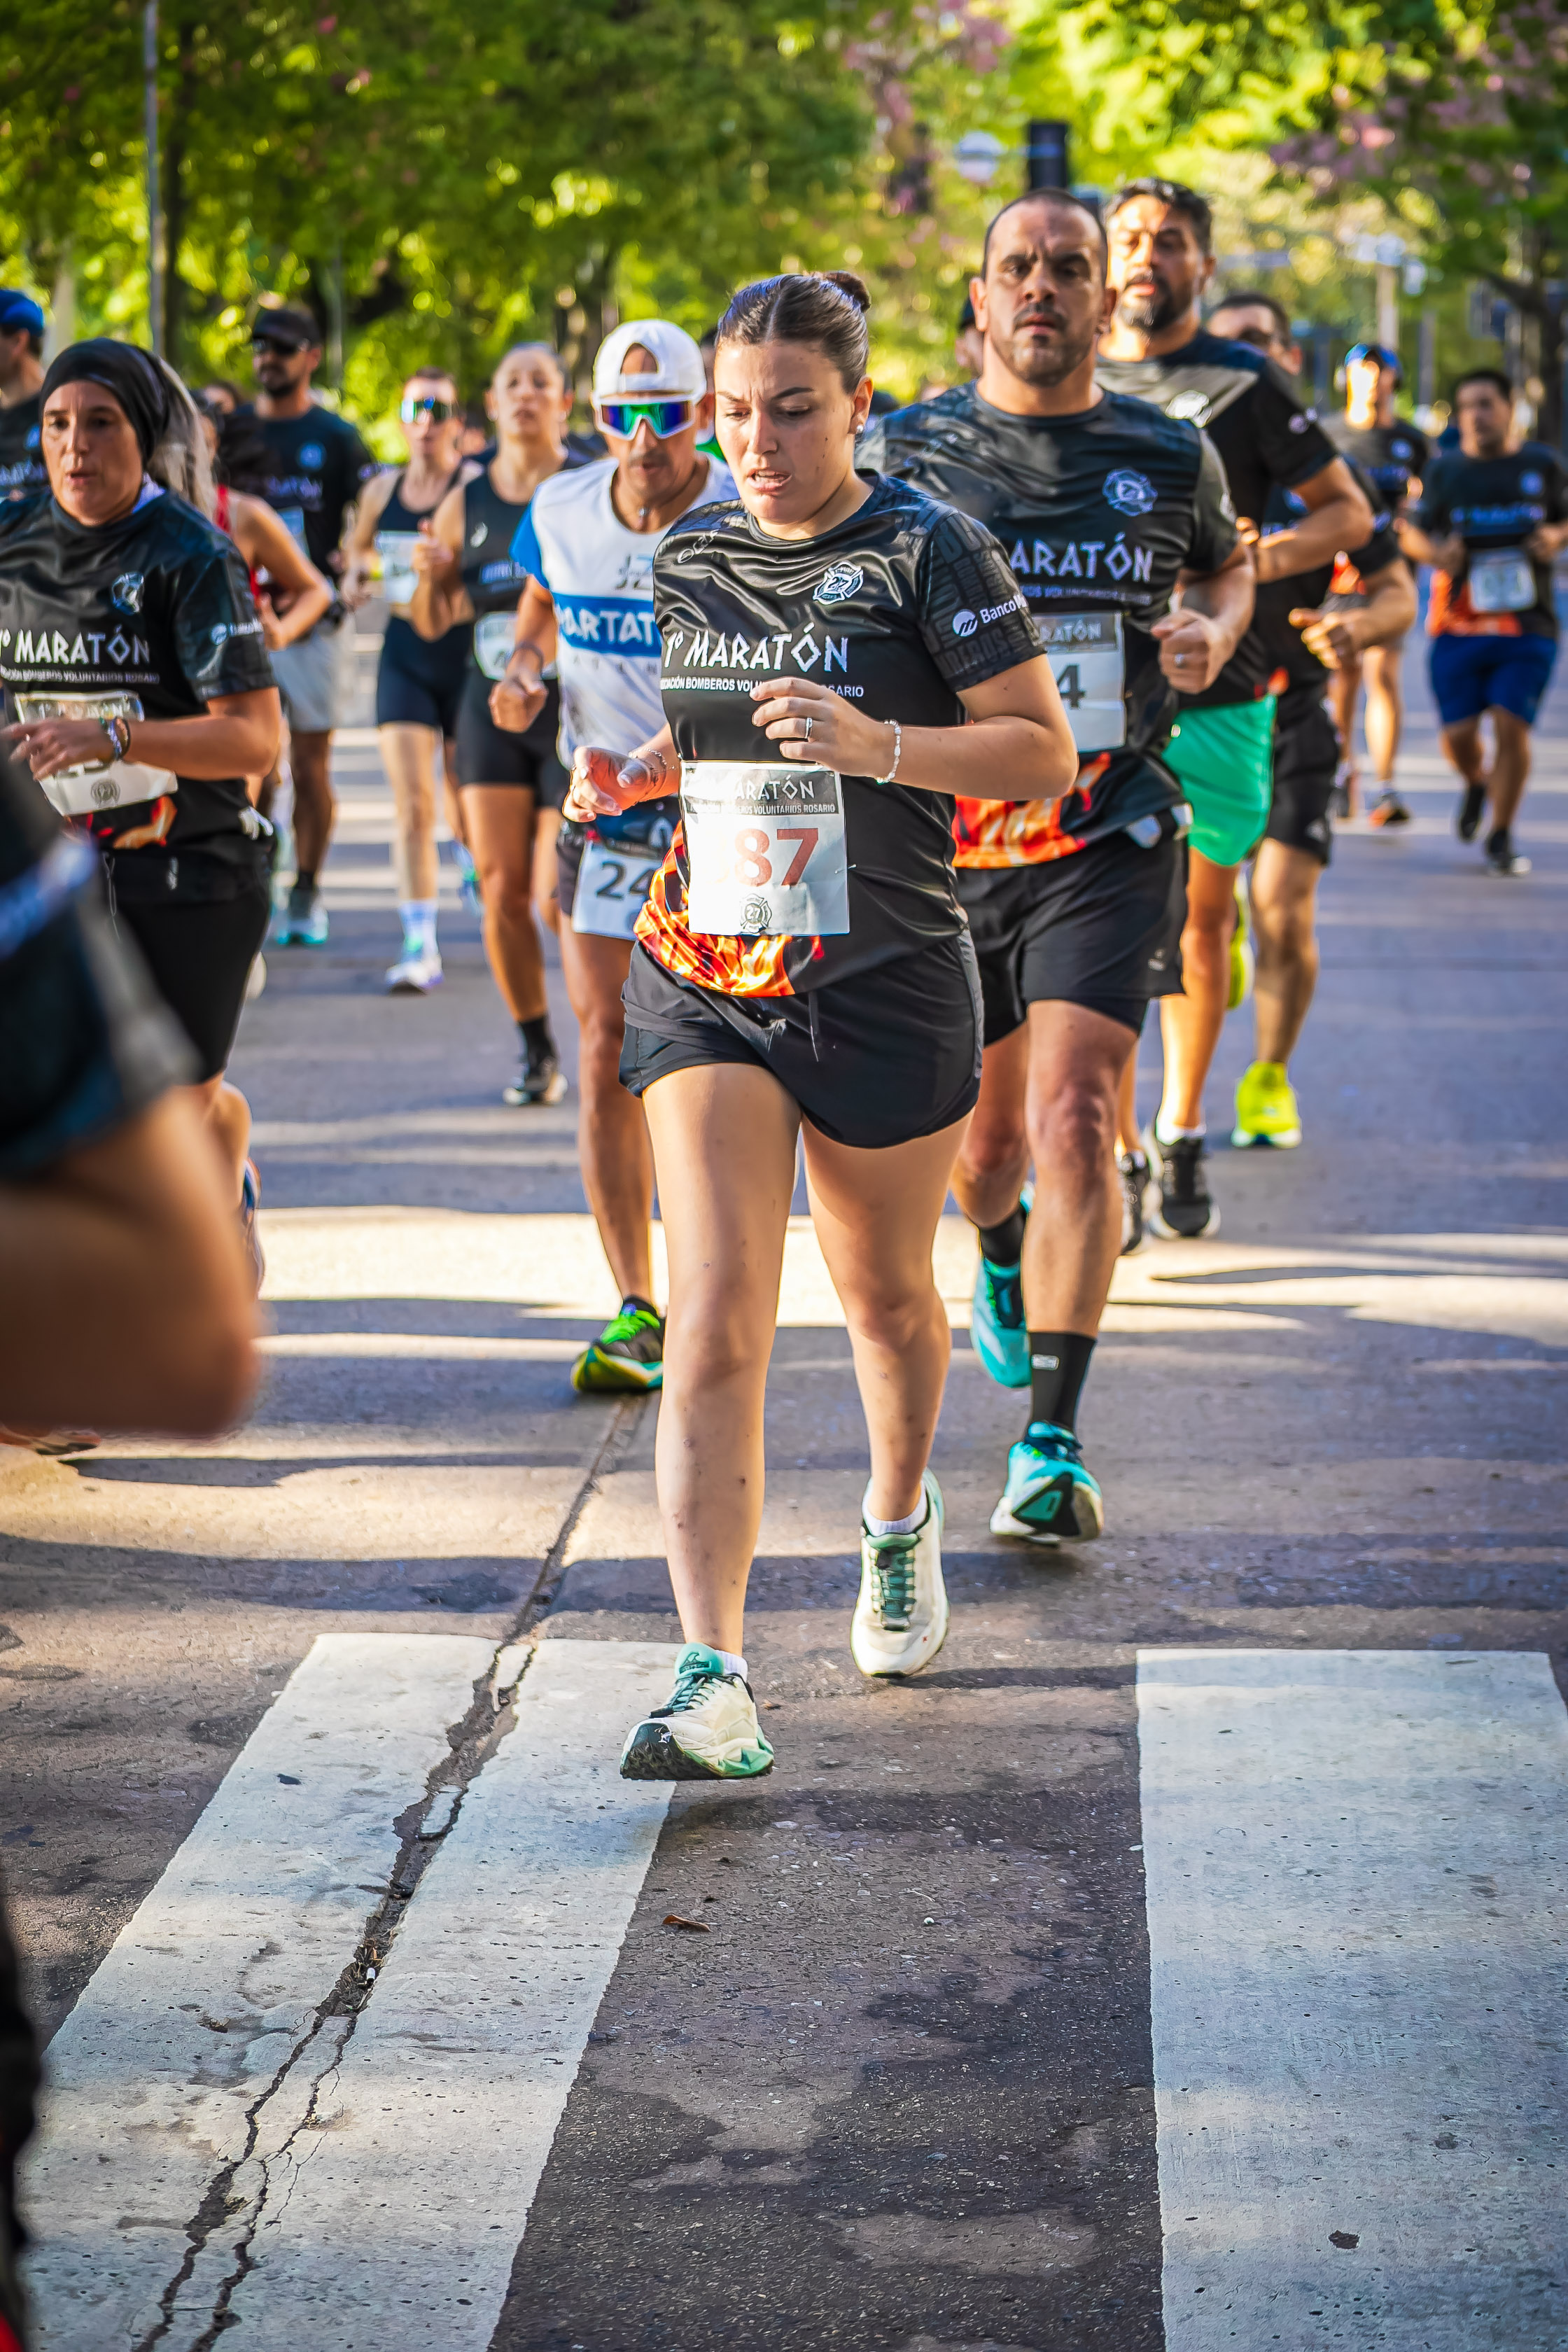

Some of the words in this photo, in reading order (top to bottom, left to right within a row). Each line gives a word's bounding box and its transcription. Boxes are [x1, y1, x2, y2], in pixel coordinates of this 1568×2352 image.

[1010, 532, 1153, 582] ARATÓN
[15, 624, 150, 665] MARATÓN
[683, 622, 848, 673] MARATÓN
[1040, 620, 1102, 641] RATÓN
[685, 676, 735, 692] BOMBEROS
[829, 685, 864, 697] ARIO
[735, 775, 816, 802] ARATÓN
[753, 805, 802, 815] VOLUNTARIOS
[804, 803, 836, 813] ROSARIO
[708, 827, 819, 888] 87
